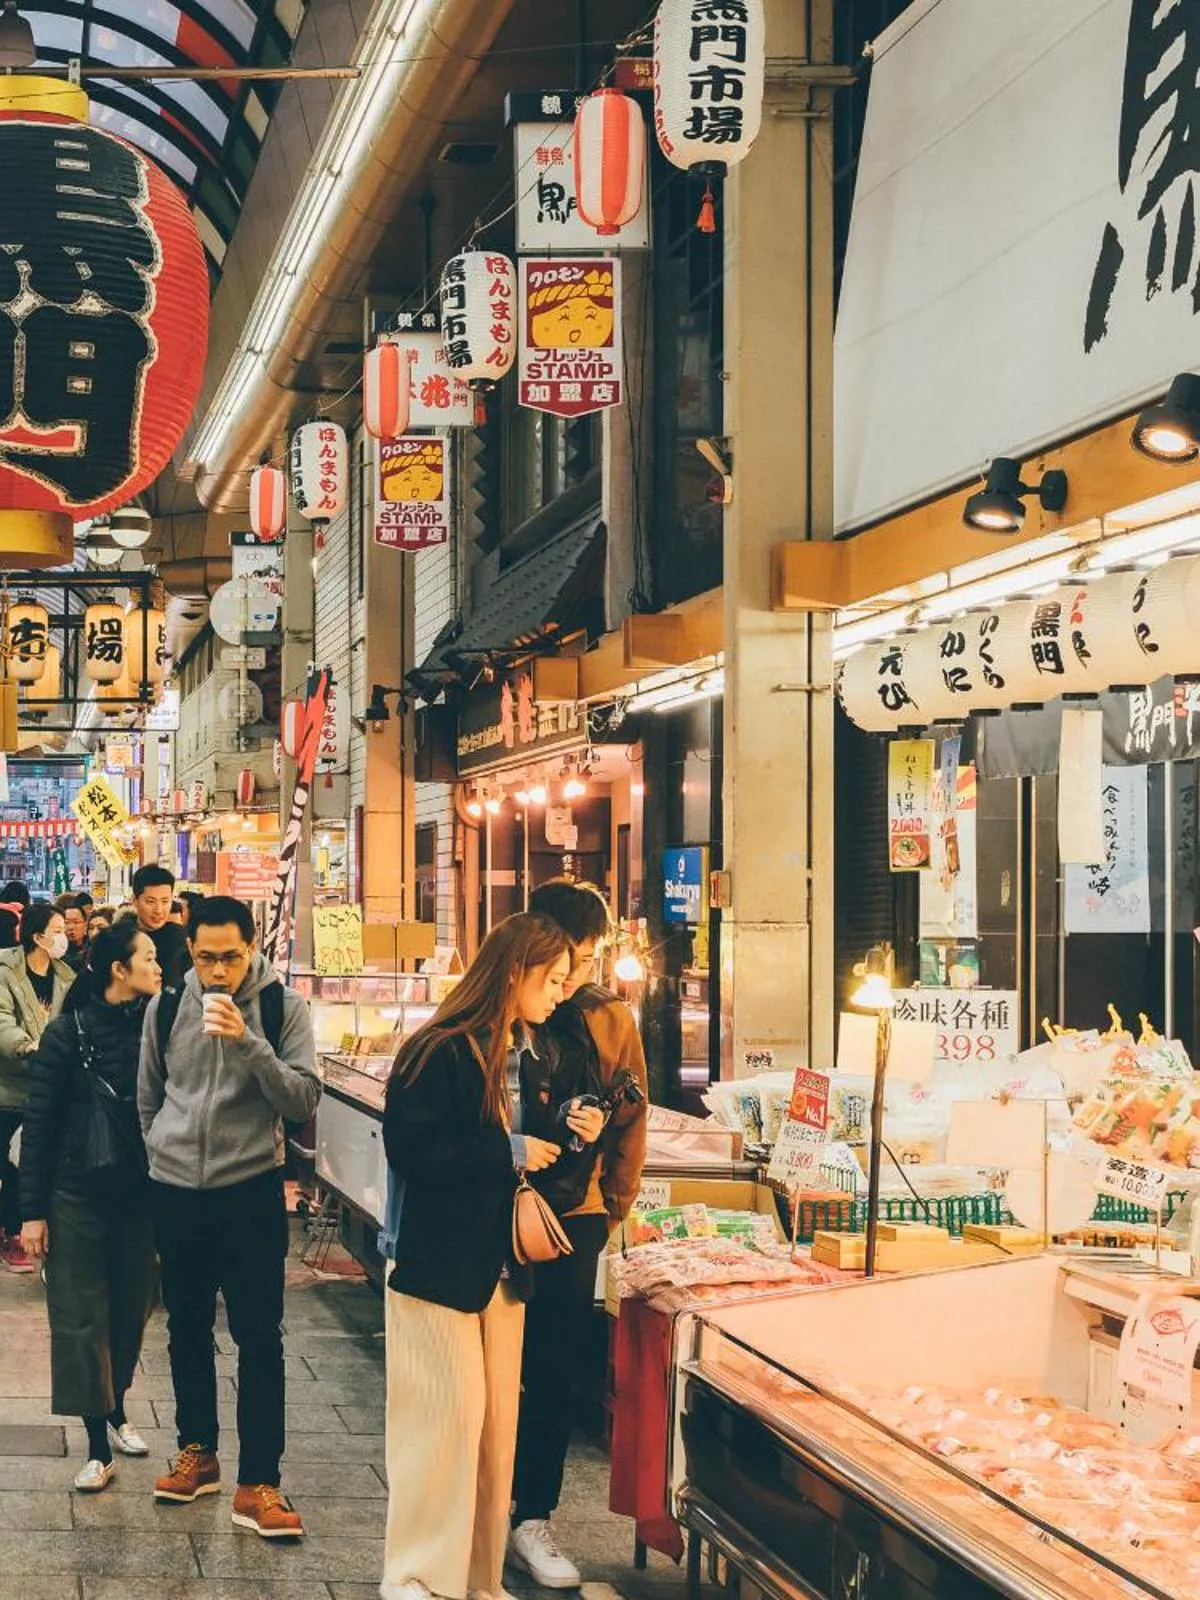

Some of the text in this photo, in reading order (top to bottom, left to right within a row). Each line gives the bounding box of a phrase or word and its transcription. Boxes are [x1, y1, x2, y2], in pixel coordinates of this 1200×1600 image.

[529, 266, 584, 287] クロモン
[485, 255, 511, 368] ほんまもん
[533, 348, 604, 362] フレッシュ
[527, 362, 614, 380] STAMP
[527, 383, 614, 403] 加盟店
[381, 443, 423, 459] クロモン
[317, 427, 338, 510] ほんまもん
[384, 501, 436, 513] フレッシュ
[379, 512, 443, 525] STAMP
[893, 998, 1010, 1030] 珍味各種
